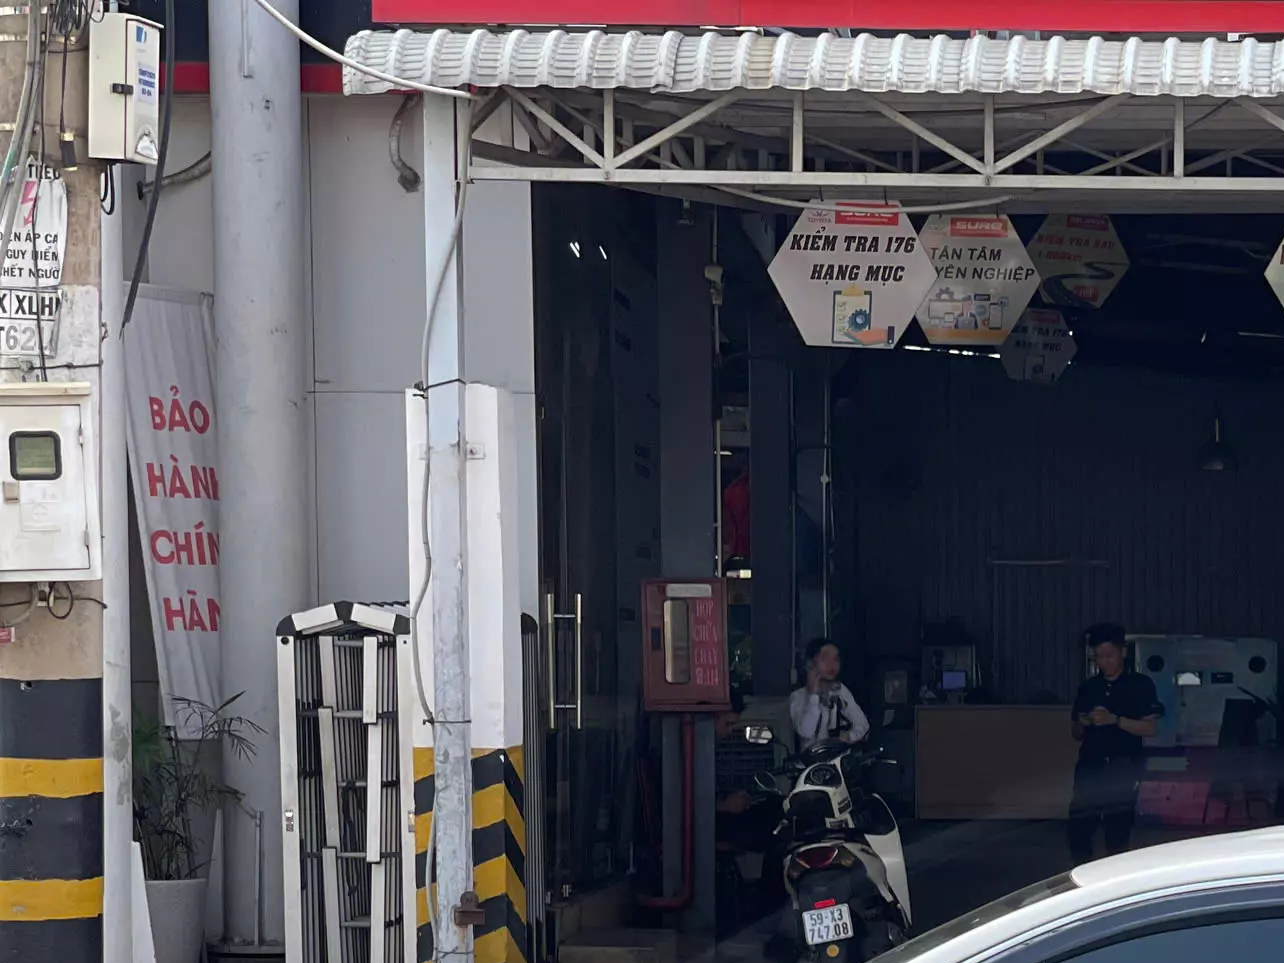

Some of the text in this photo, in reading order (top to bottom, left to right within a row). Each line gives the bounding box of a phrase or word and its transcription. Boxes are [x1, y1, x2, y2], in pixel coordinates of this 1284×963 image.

[955, 220, 1004, 231] SURE
[44, 233, 58, 244] CA
[789, 226, 917, 254] KIỂM TRA 176
[6, 248, 27, 260] GUY
[967, 246, 1002, 262] TÂM
[0, 263, 59, 280] HẾT NGƯỜ
[810, 263, 906, 287] HẠNG MỤC
[935, 264, 1036, 283] YÊN NGHIỆP
[148, 385, 210, 434] BẢO
[150, 520, 220, 566] CHÍN
